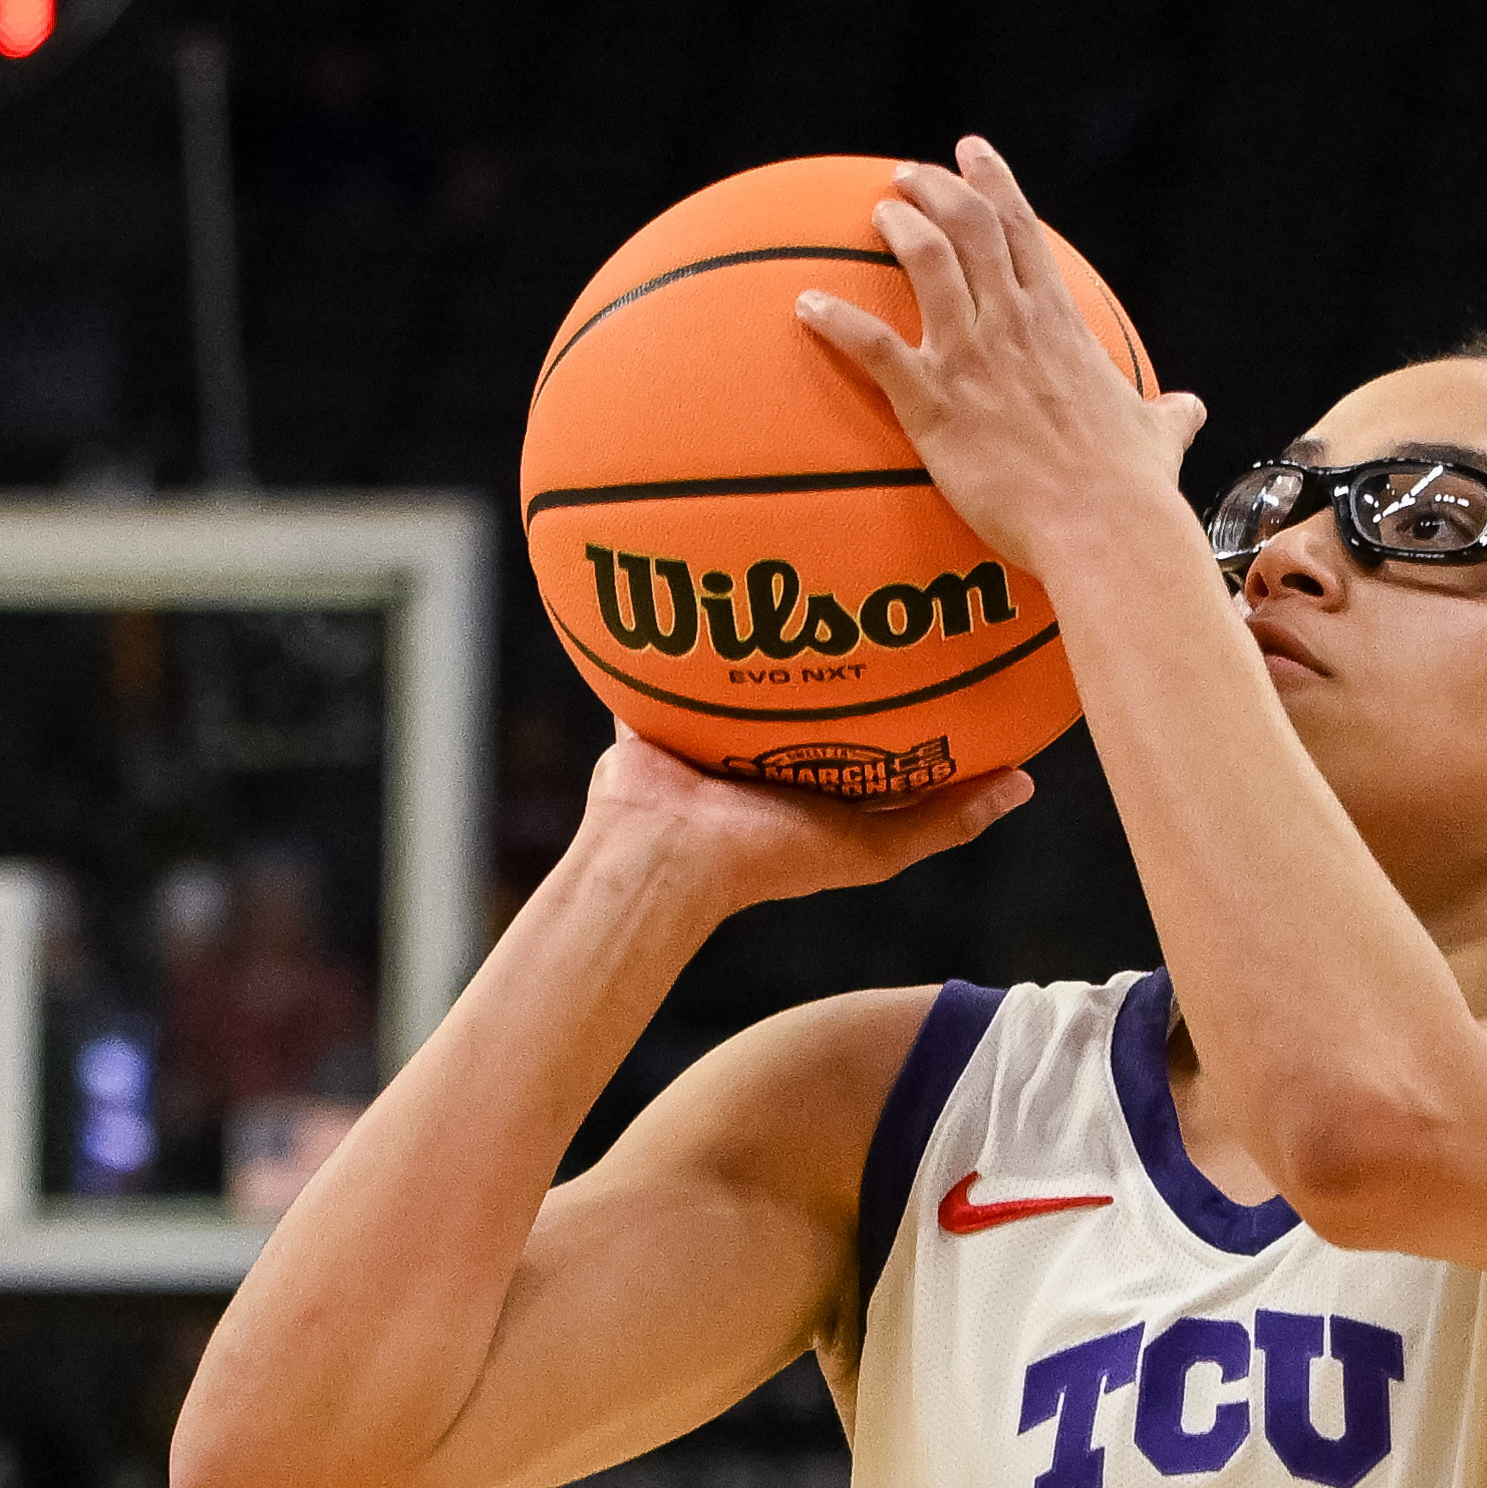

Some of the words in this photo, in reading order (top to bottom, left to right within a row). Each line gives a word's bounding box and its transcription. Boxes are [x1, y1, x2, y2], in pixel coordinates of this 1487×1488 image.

[585, 542, 1019, 661] Wilson
[729, 669, 791, 685] EVO
[801, 664, 867, 684] NXT
